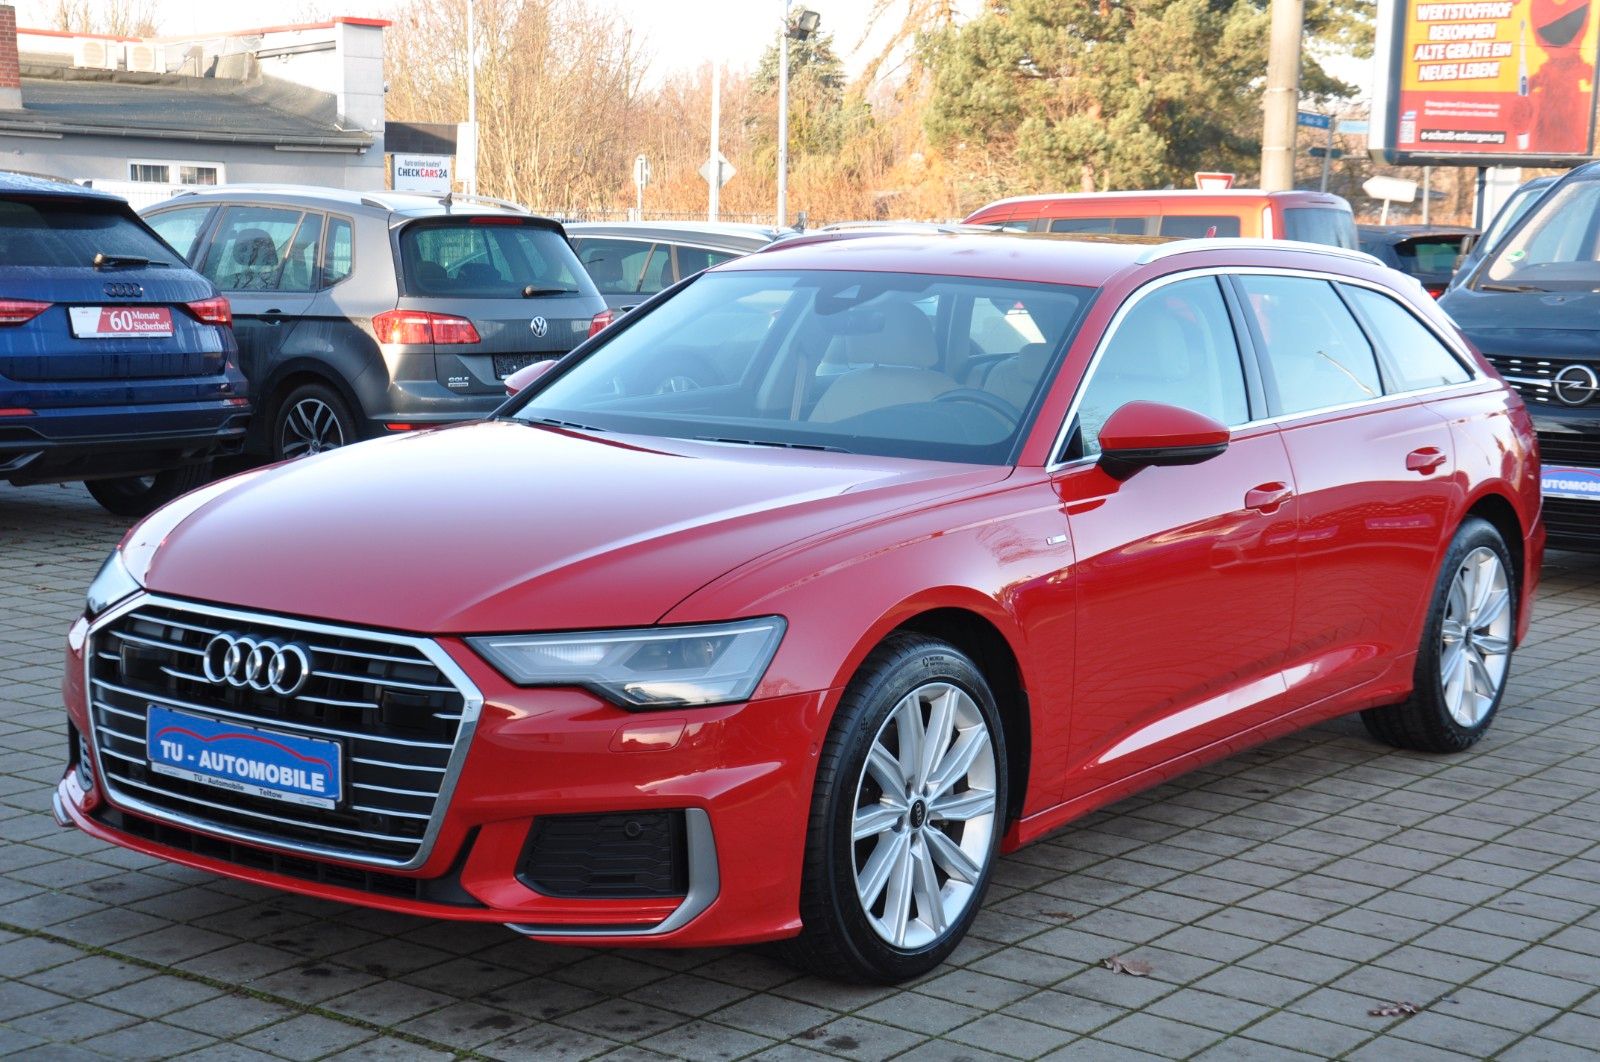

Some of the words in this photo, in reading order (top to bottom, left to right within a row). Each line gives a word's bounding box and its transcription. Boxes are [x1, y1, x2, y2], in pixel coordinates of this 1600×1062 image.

[1416, 2, 1513, 21] WERTSTOFFHOF
[1428, 23, 1497, 40] BEKOMMEN
[1413, 44, 1446, 61] ALTE
[1418, 63, 1459, 81] NEUES
[109, 310, 133, 331] 60
[131, 310, 160, 320] Monate
[1541, 478, 1600, 493] UTOMOB
[159, 739, 183, 762] TU
[199, 749, 325, 793] AUTOMOBILE
[193, 773, 203, 782] TU
[208, 776, 245, 792] Automobile
[258, 787, 283, 800] Teltow
